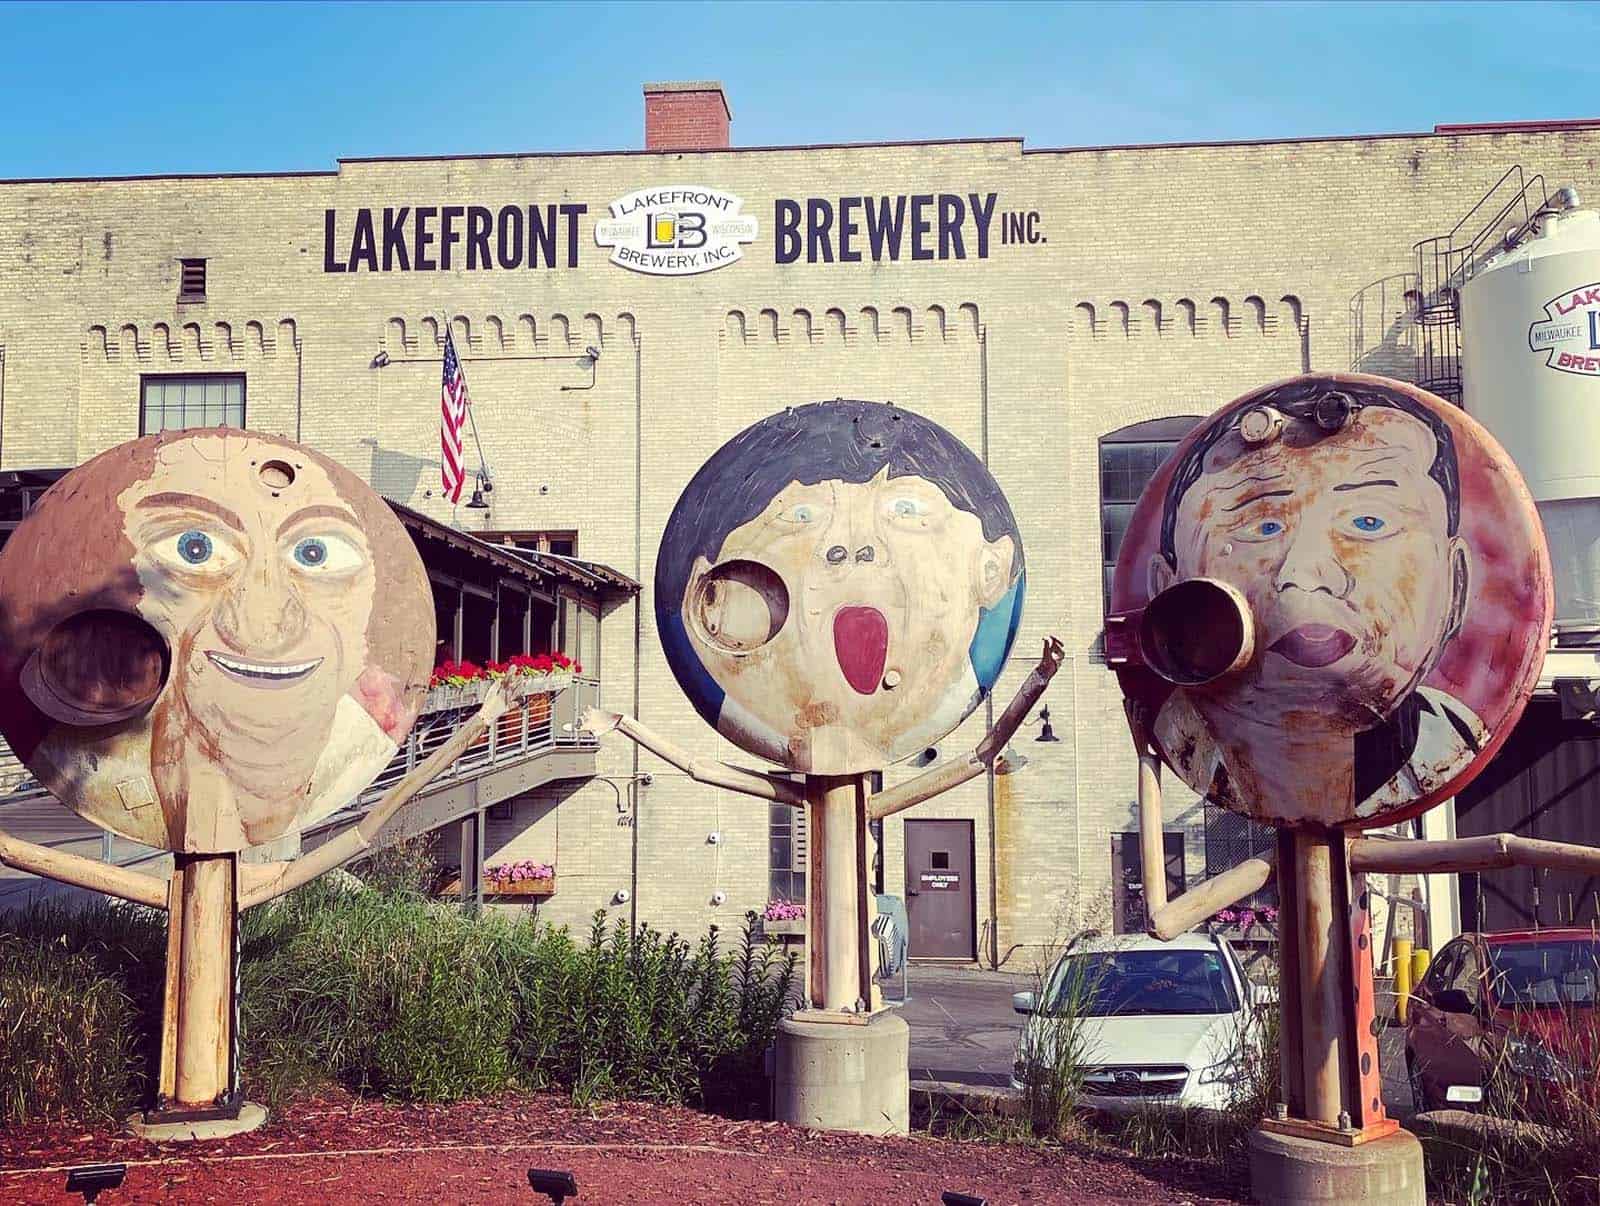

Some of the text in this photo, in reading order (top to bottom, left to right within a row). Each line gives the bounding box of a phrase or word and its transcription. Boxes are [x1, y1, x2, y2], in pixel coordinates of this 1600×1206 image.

[619, 191, 734, 216] LAKEFRONT
[324, 192, 1047, 273] LAKEFRONT BREWERY INC.
[703, 245, 736, 265] INC.
[1535, 326, 1584, 342] MILWAUKEE
[1557, 352, 1600, 371] BRE
